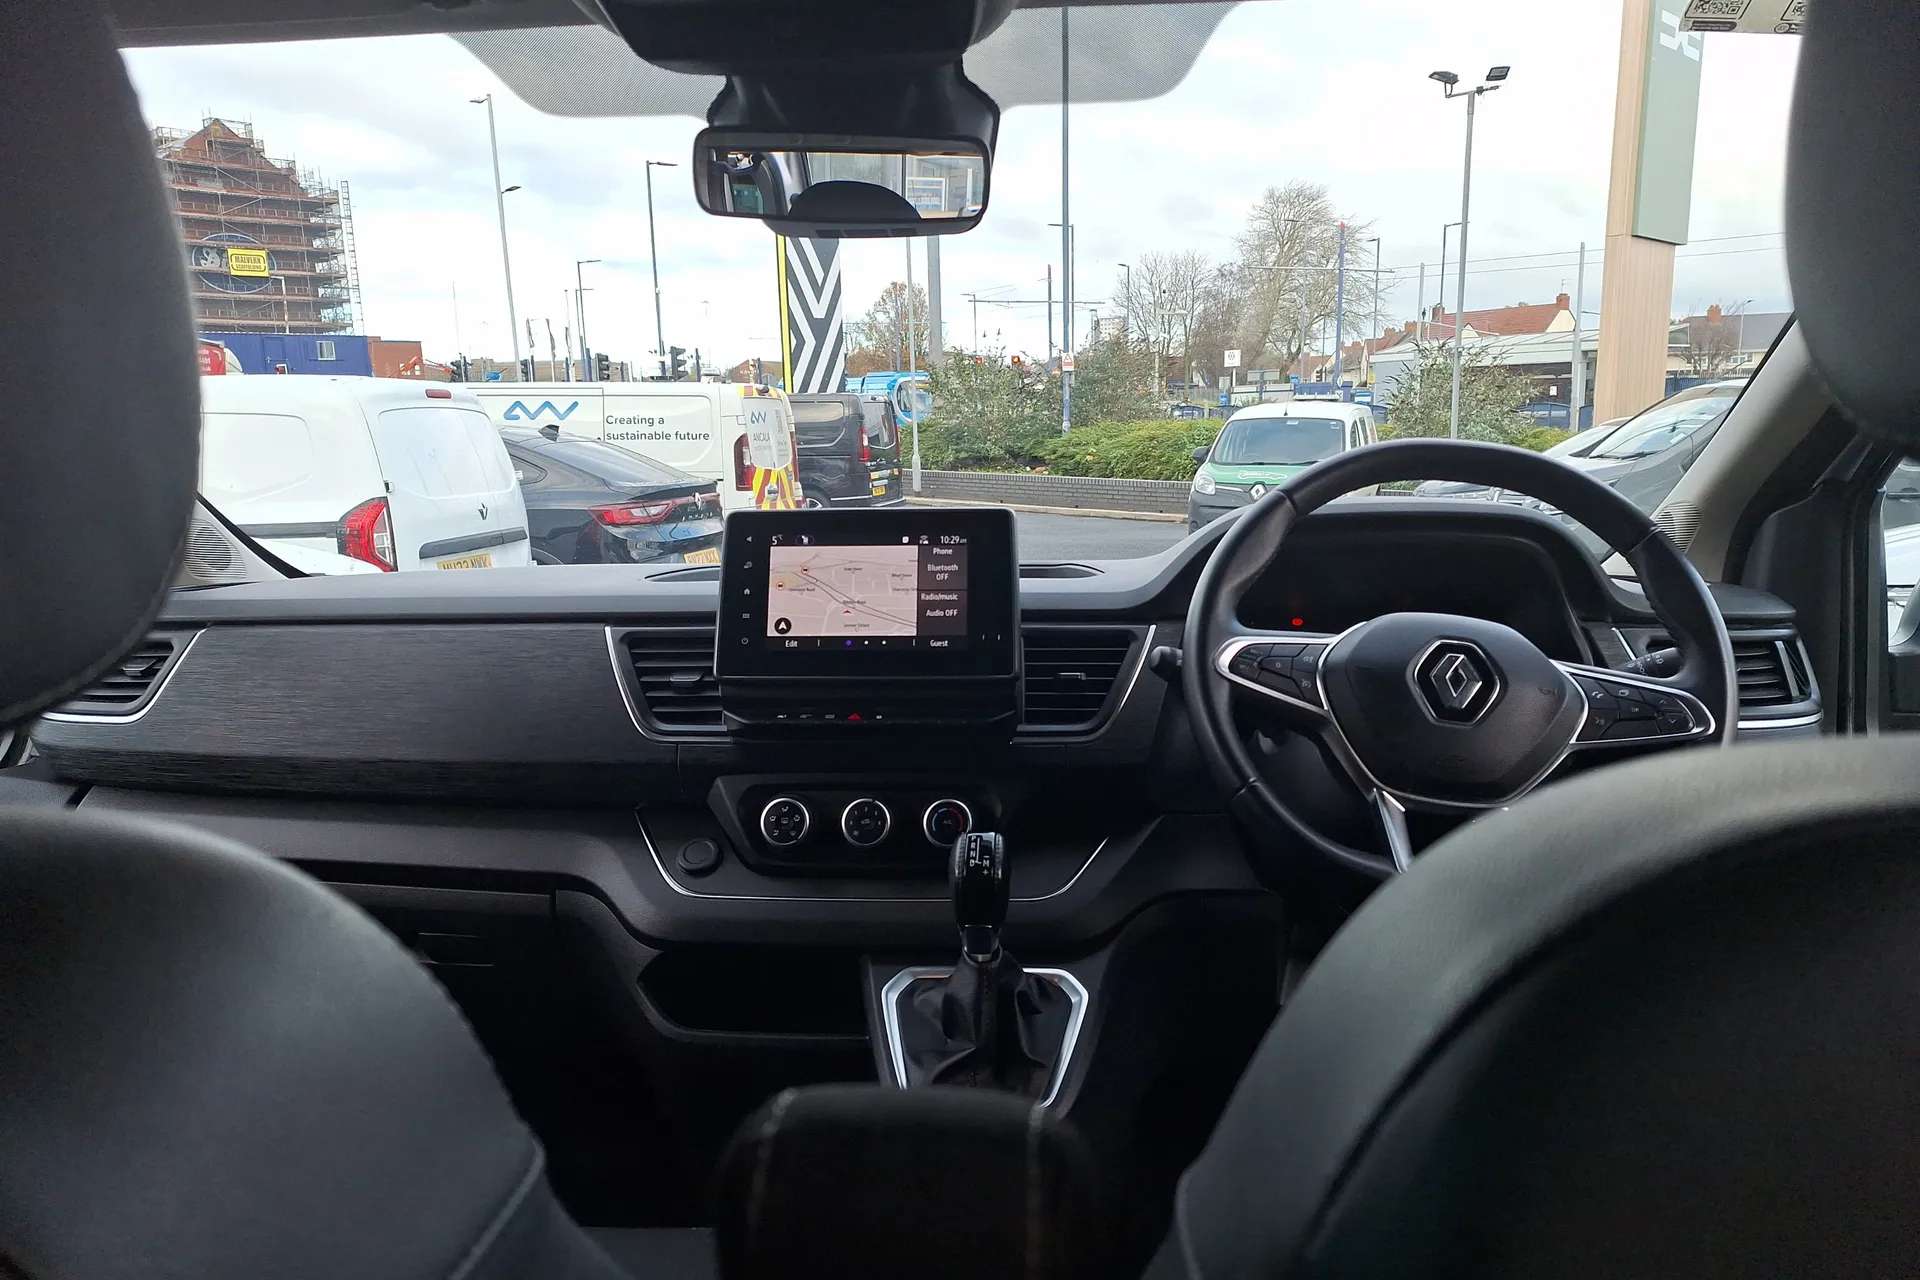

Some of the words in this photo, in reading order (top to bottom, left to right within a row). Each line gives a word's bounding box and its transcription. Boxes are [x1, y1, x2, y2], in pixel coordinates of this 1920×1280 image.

[605, 415, 655, 427] Creating
[658, 417, 665, 425] a
[606, 430, 672, 441] sustainable
[674, 430, 710, 441] future
[940, 535, 959, 544] 10:29
[932, 547, 953, 555] Phone
[927, 564, 959, 572] Bluetooth
[936, 573, 949, 581] OFF
[920, 592, 959, 601] Radio/music
[925, 609, 944, 617] Audio
[945, 609, 958, 617] OFF
[785, 639, 798, 648] Edit
[929, 639, 949, 647] Guest
